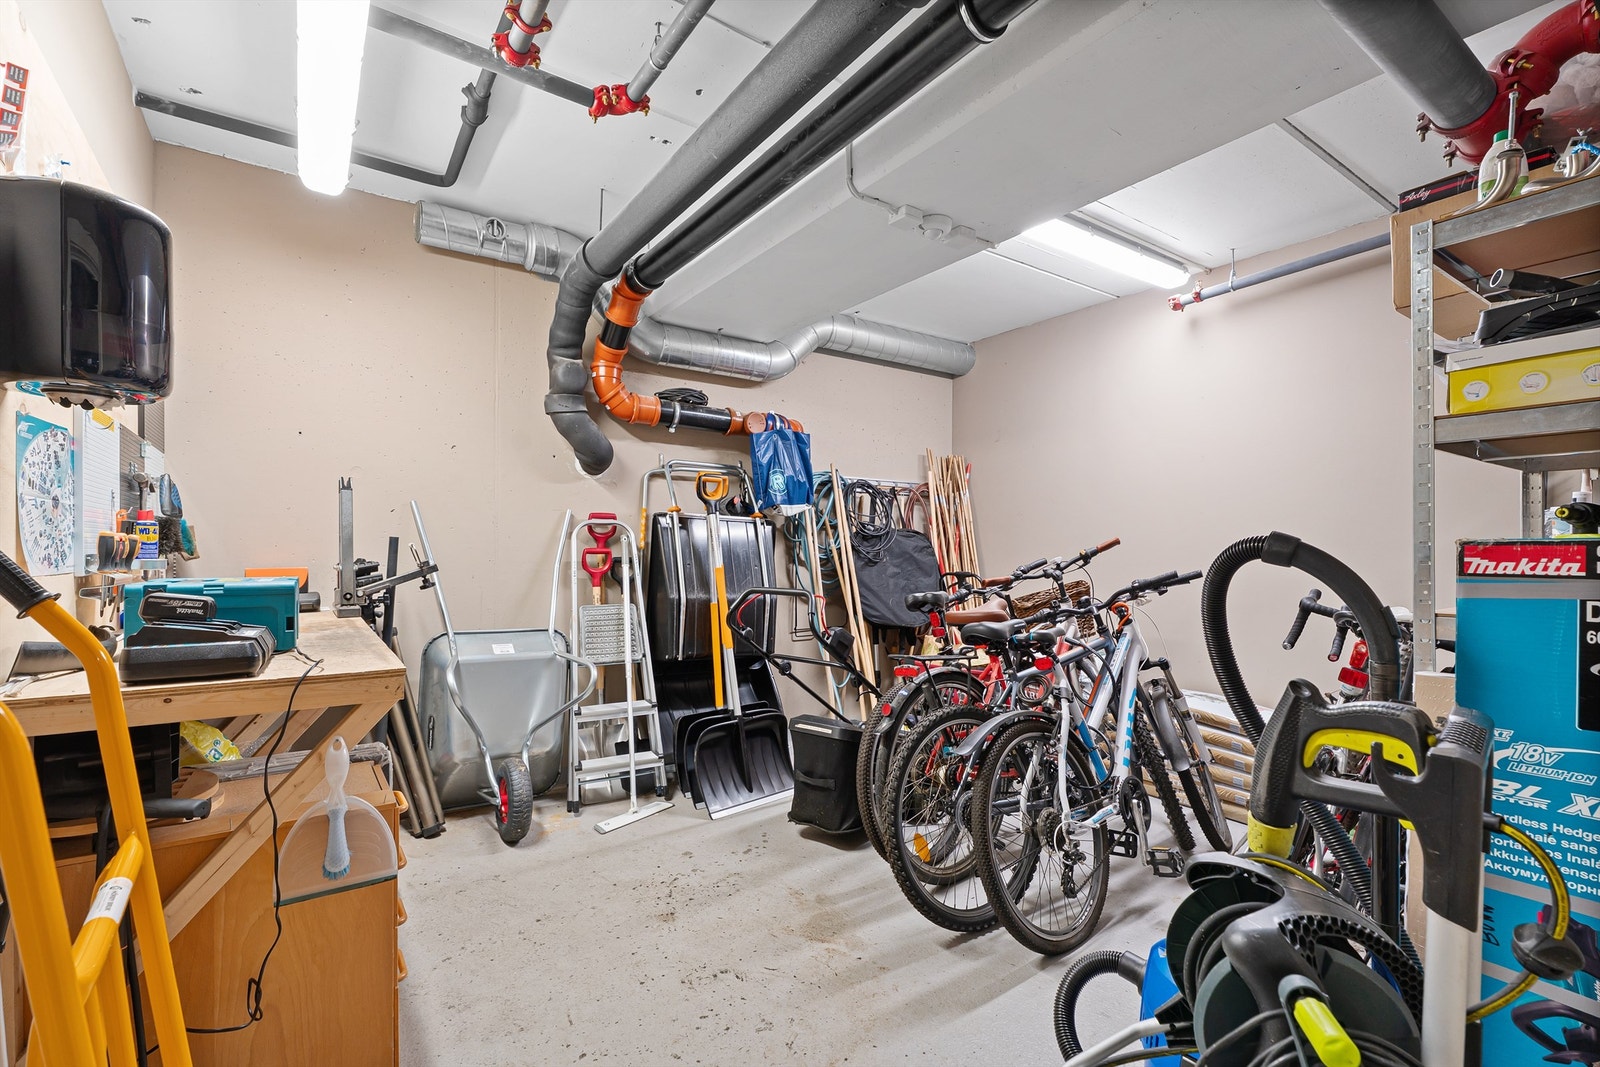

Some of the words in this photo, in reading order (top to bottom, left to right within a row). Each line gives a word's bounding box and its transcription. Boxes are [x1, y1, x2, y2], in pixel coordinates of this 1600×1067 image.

[1508, 742, 1565, 766] 18V
[1507, 762, 1597, 786] LITHIUM-ION
[1492, 794, 1549, 811] OTOR
[1491, 811, 1548, 831] rdless
[1552, 823, 1600, 843] Hedge
[1560, 840, 1598, 855] sans
